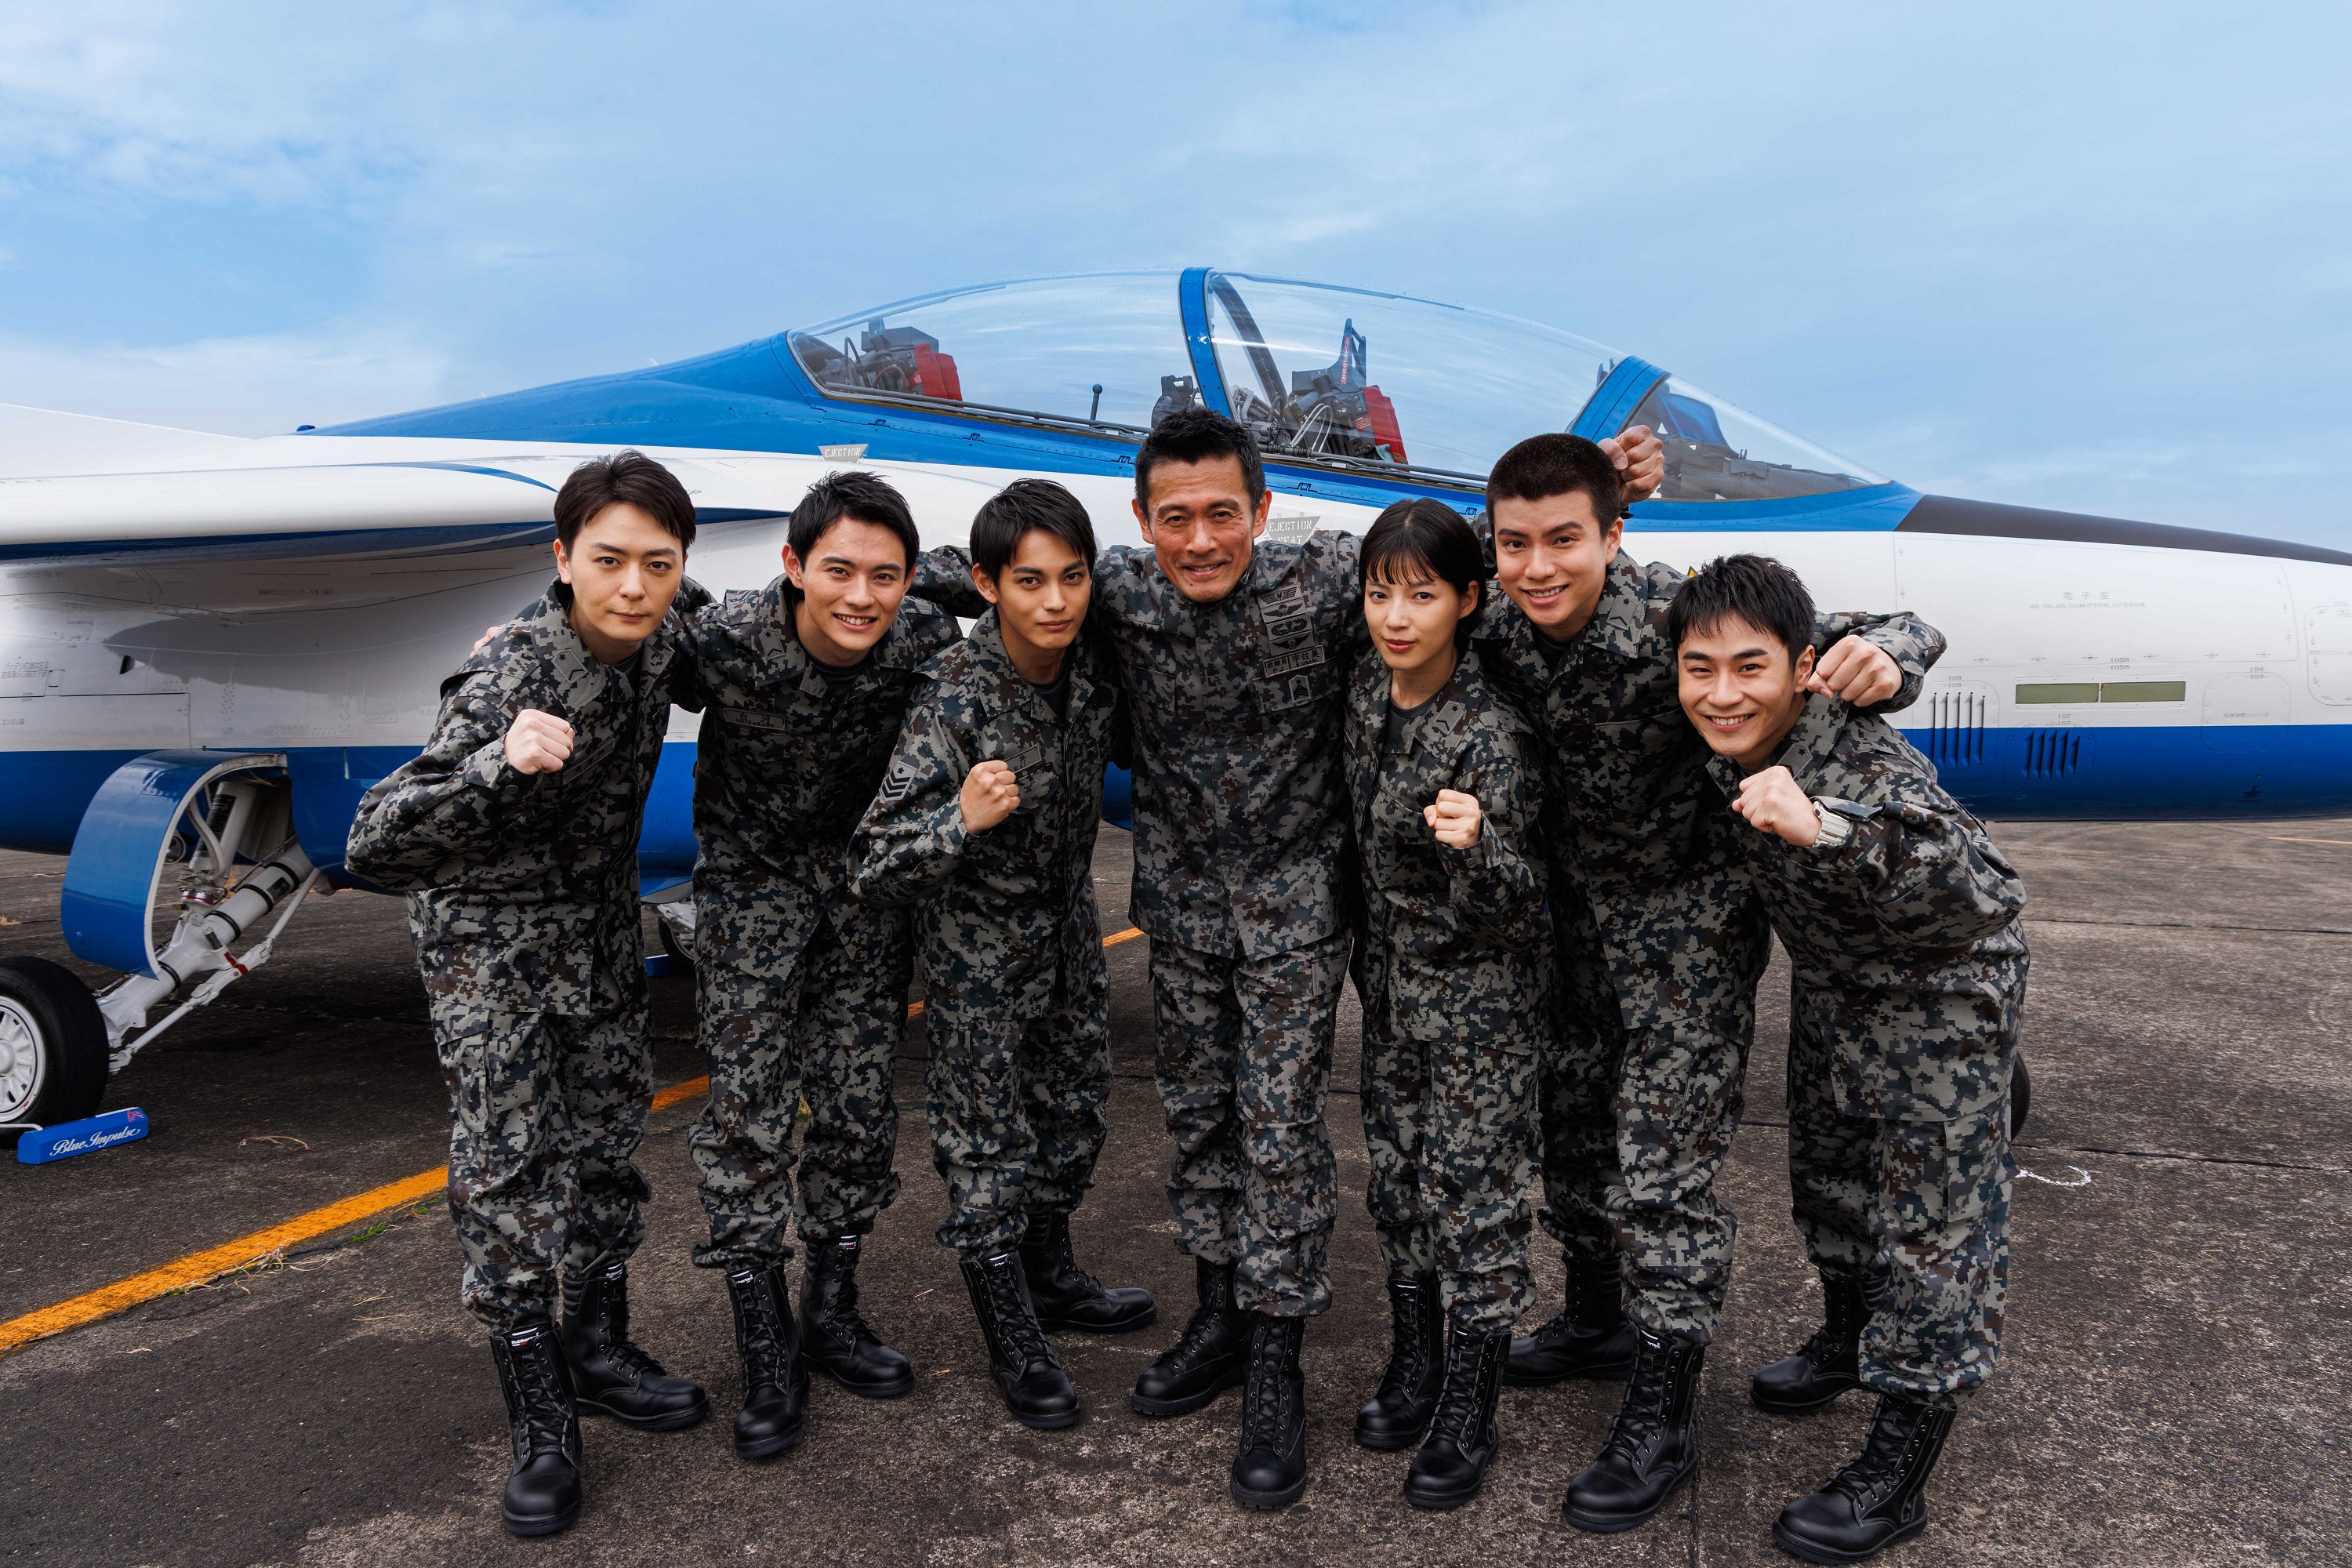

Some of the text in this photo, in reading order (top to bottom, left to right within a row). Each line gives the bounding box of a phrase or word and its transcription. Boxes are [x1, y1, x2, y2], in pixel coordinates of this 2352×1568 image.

[824, 447, 861, 458] EJECTION
[1269, 520, 1312, 532] EJECTION
[1291, 649, 1320, 663] 宇佐美
[735, 718, 775, 728] SHIRAKAWA
[739, 713, 771, 723] 白河
[49, 1126, 141, 1156] Blue Impulse
